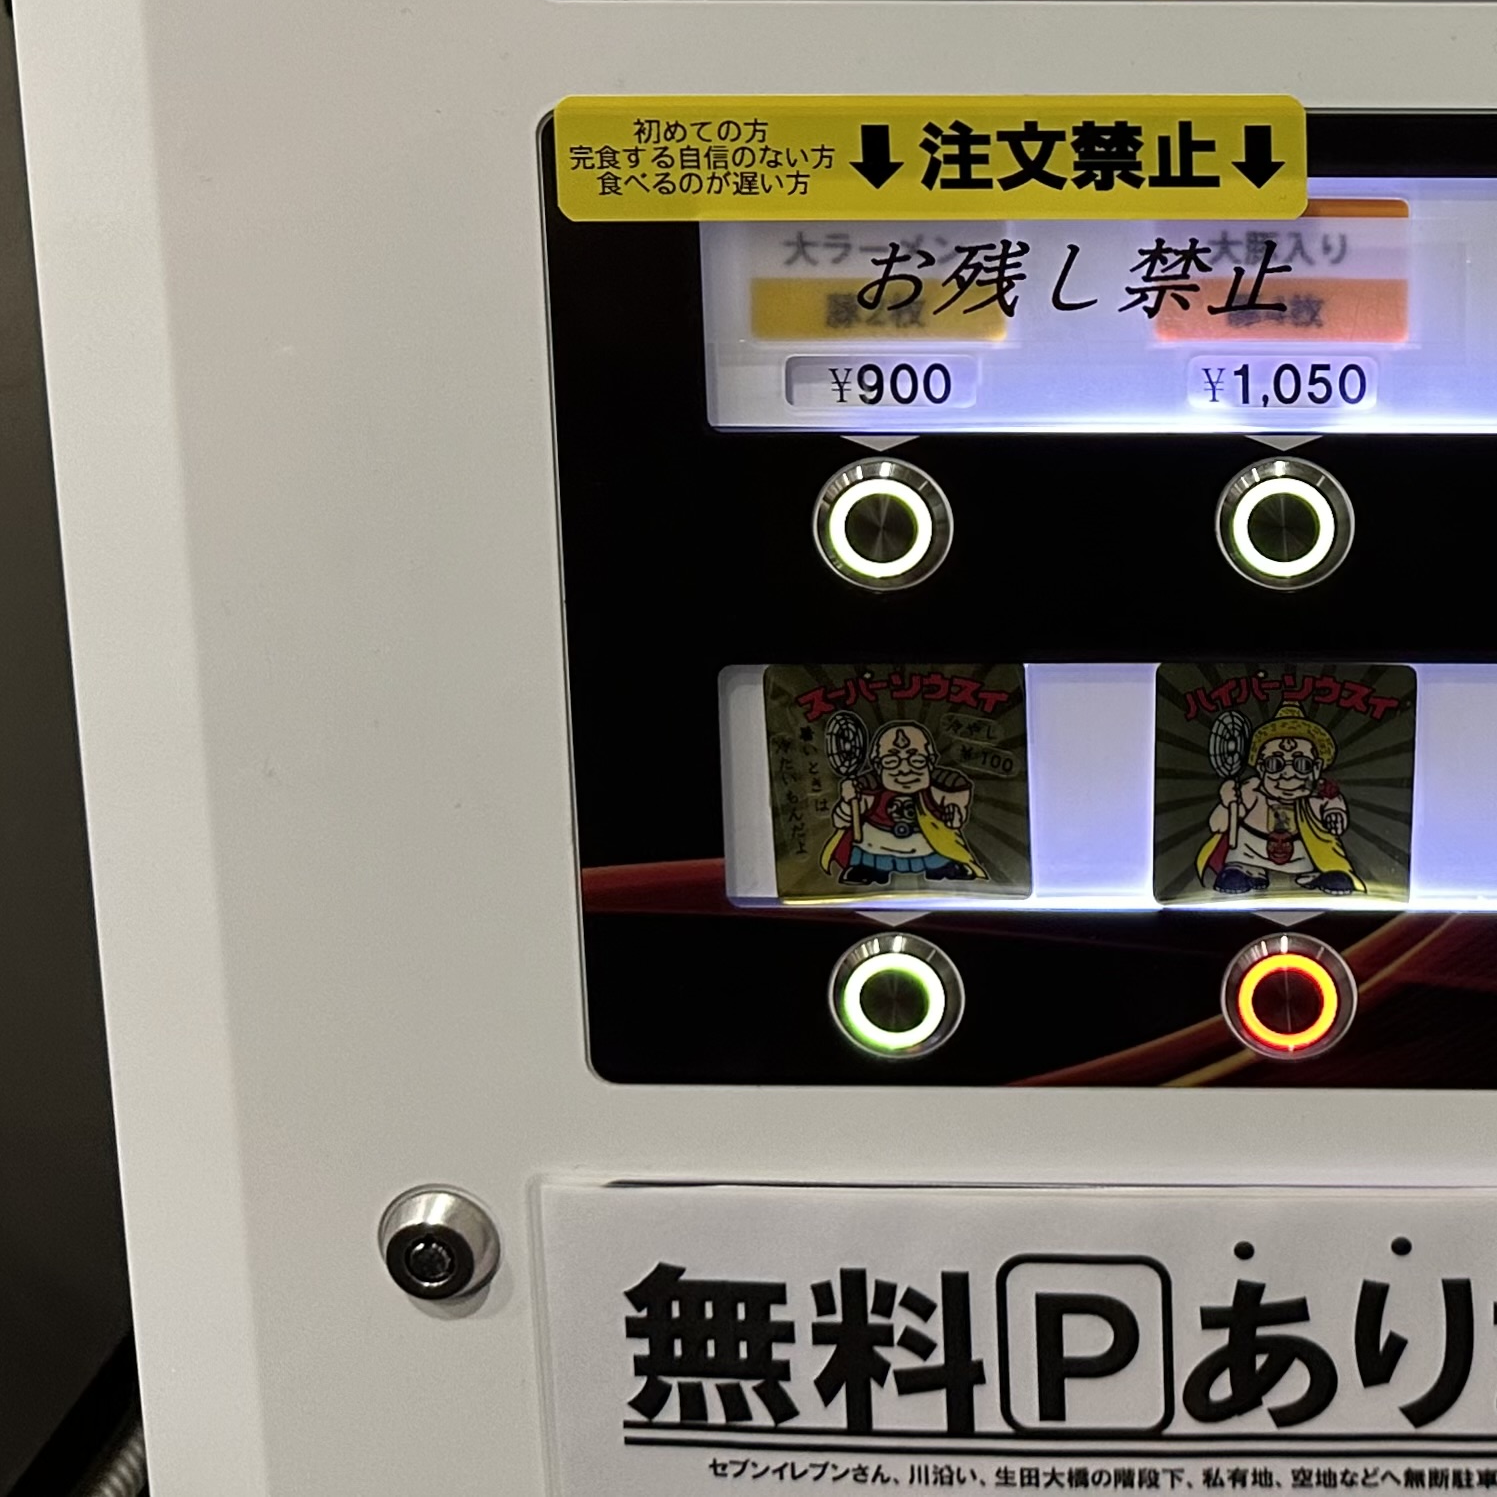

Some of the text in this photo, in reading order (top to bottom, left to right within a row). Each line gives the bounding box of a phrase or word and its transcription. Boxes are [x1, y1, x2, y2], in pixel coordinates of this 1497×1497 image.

[633, 118, 769, 144] 初めての方
[569, 145, 836, 171] 完食する自信のない方
[919, 120, 1222, 192] 注文禁止
[597, 170, 811, 196] 食べるのが遅い方
[856, 238, 1294, 320] お残し禁止
[830, 363, 953, 406] ¥900
[1202, 363, 1367, 409] ¥1,050
